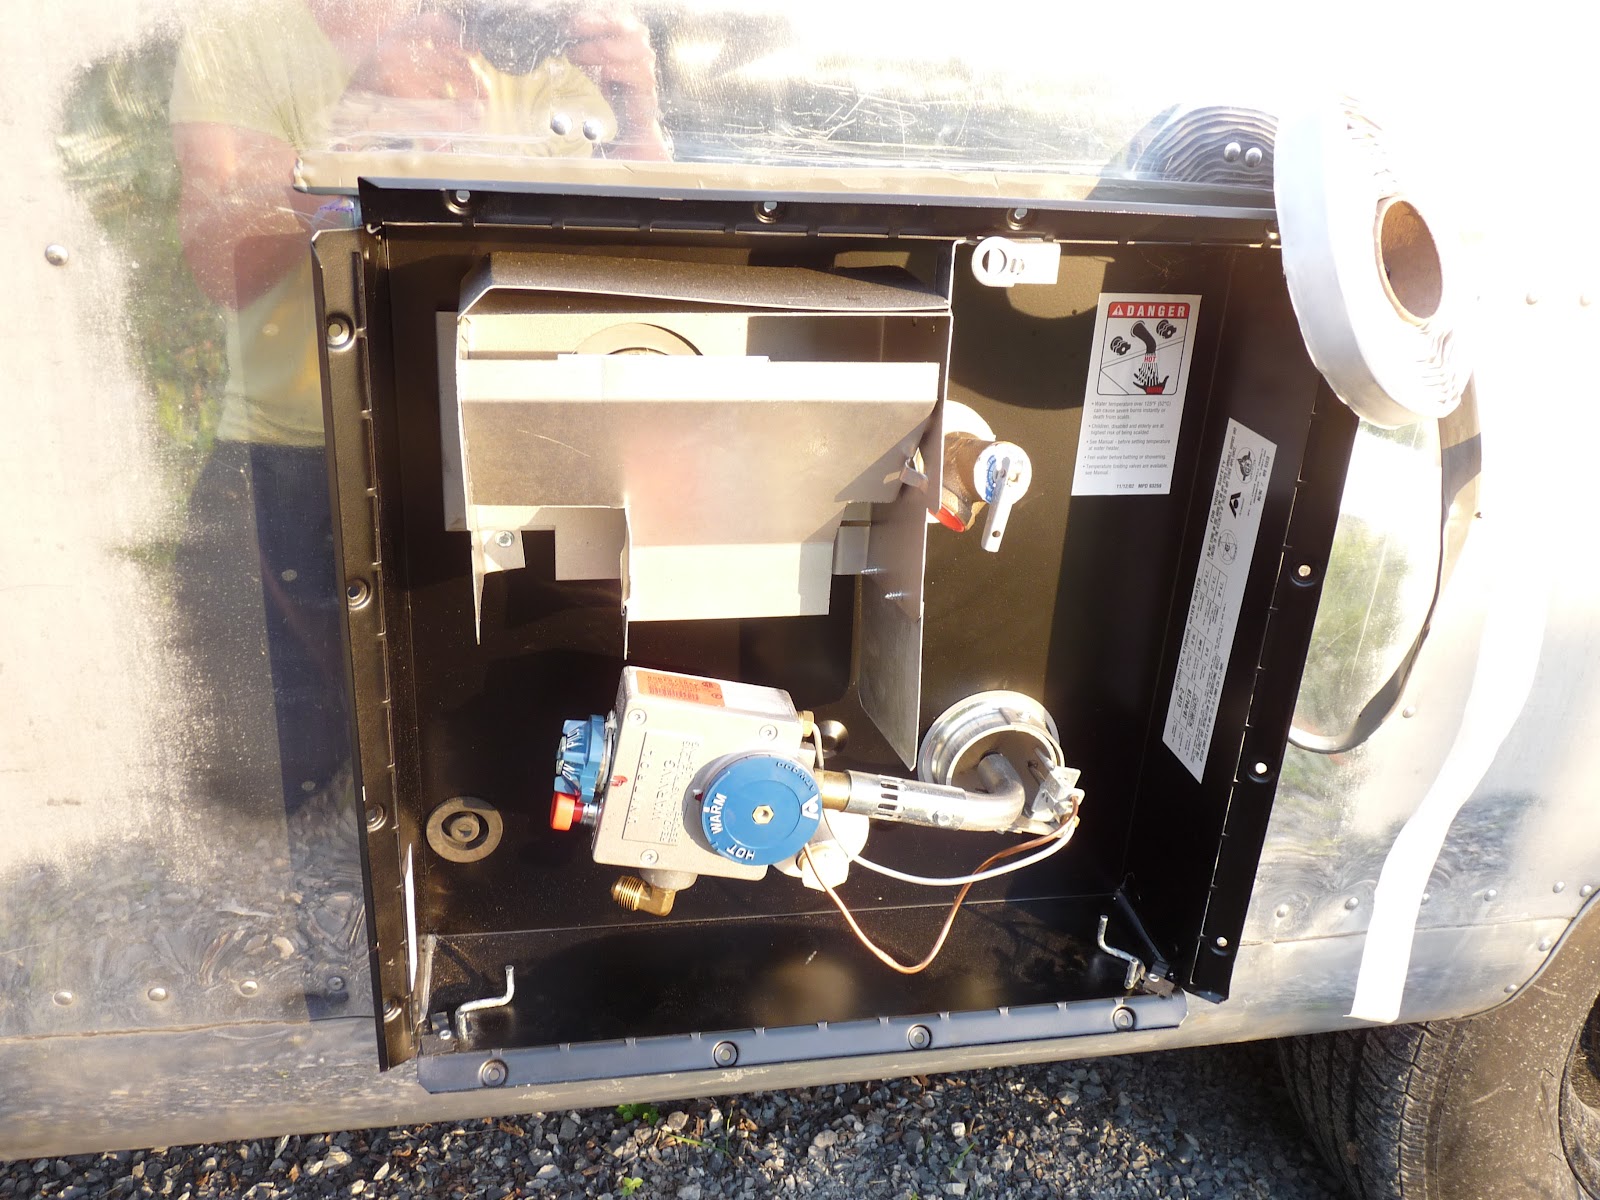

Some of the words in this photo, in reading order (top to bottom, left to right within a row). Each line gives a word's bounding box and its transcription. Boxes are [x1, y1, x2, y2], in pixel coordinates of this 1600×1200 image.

[1127, 305, 1186, 317] DANGER
[1144, 355, 1157, 363] HOT
[709, 792, 728, 835] WARM
[726, 844, 756, 860] HOT
